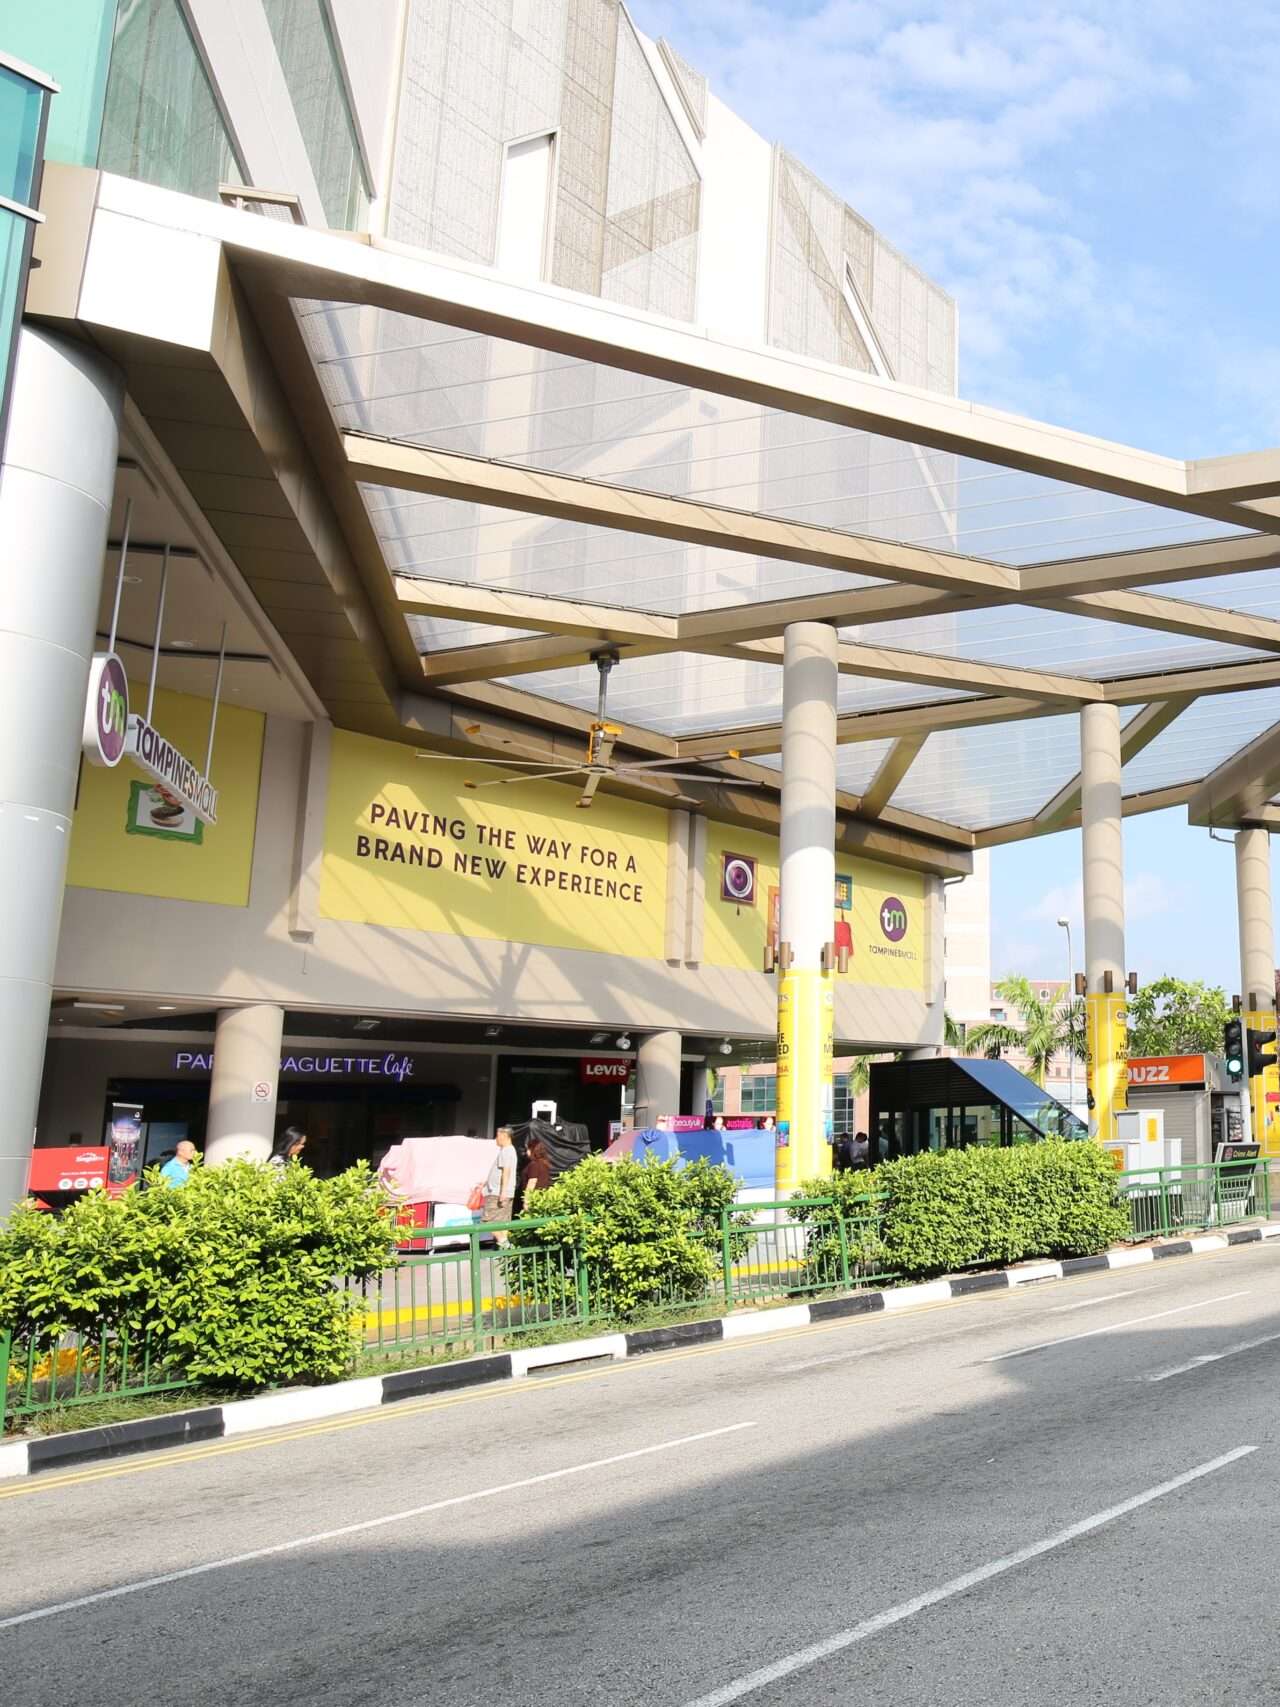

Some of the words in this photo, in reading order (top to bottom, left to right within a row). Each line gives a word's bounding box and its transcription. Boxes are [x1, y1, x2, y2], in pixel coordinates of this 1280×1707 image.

[356, 835, 443, 869] BRAND
[454, 853, 507, 880] NEW
[516, 864, 643, 903] EXPERIENCE
[370, 803, 466, 840] PAVING
[476, 824, 516, 850] THE
[527, 834, 572, 860] WAY
[580, 846, 618, 869] FOR
[625, 855, 637, 873] A
[383, 1053, 414, 1081] Café
